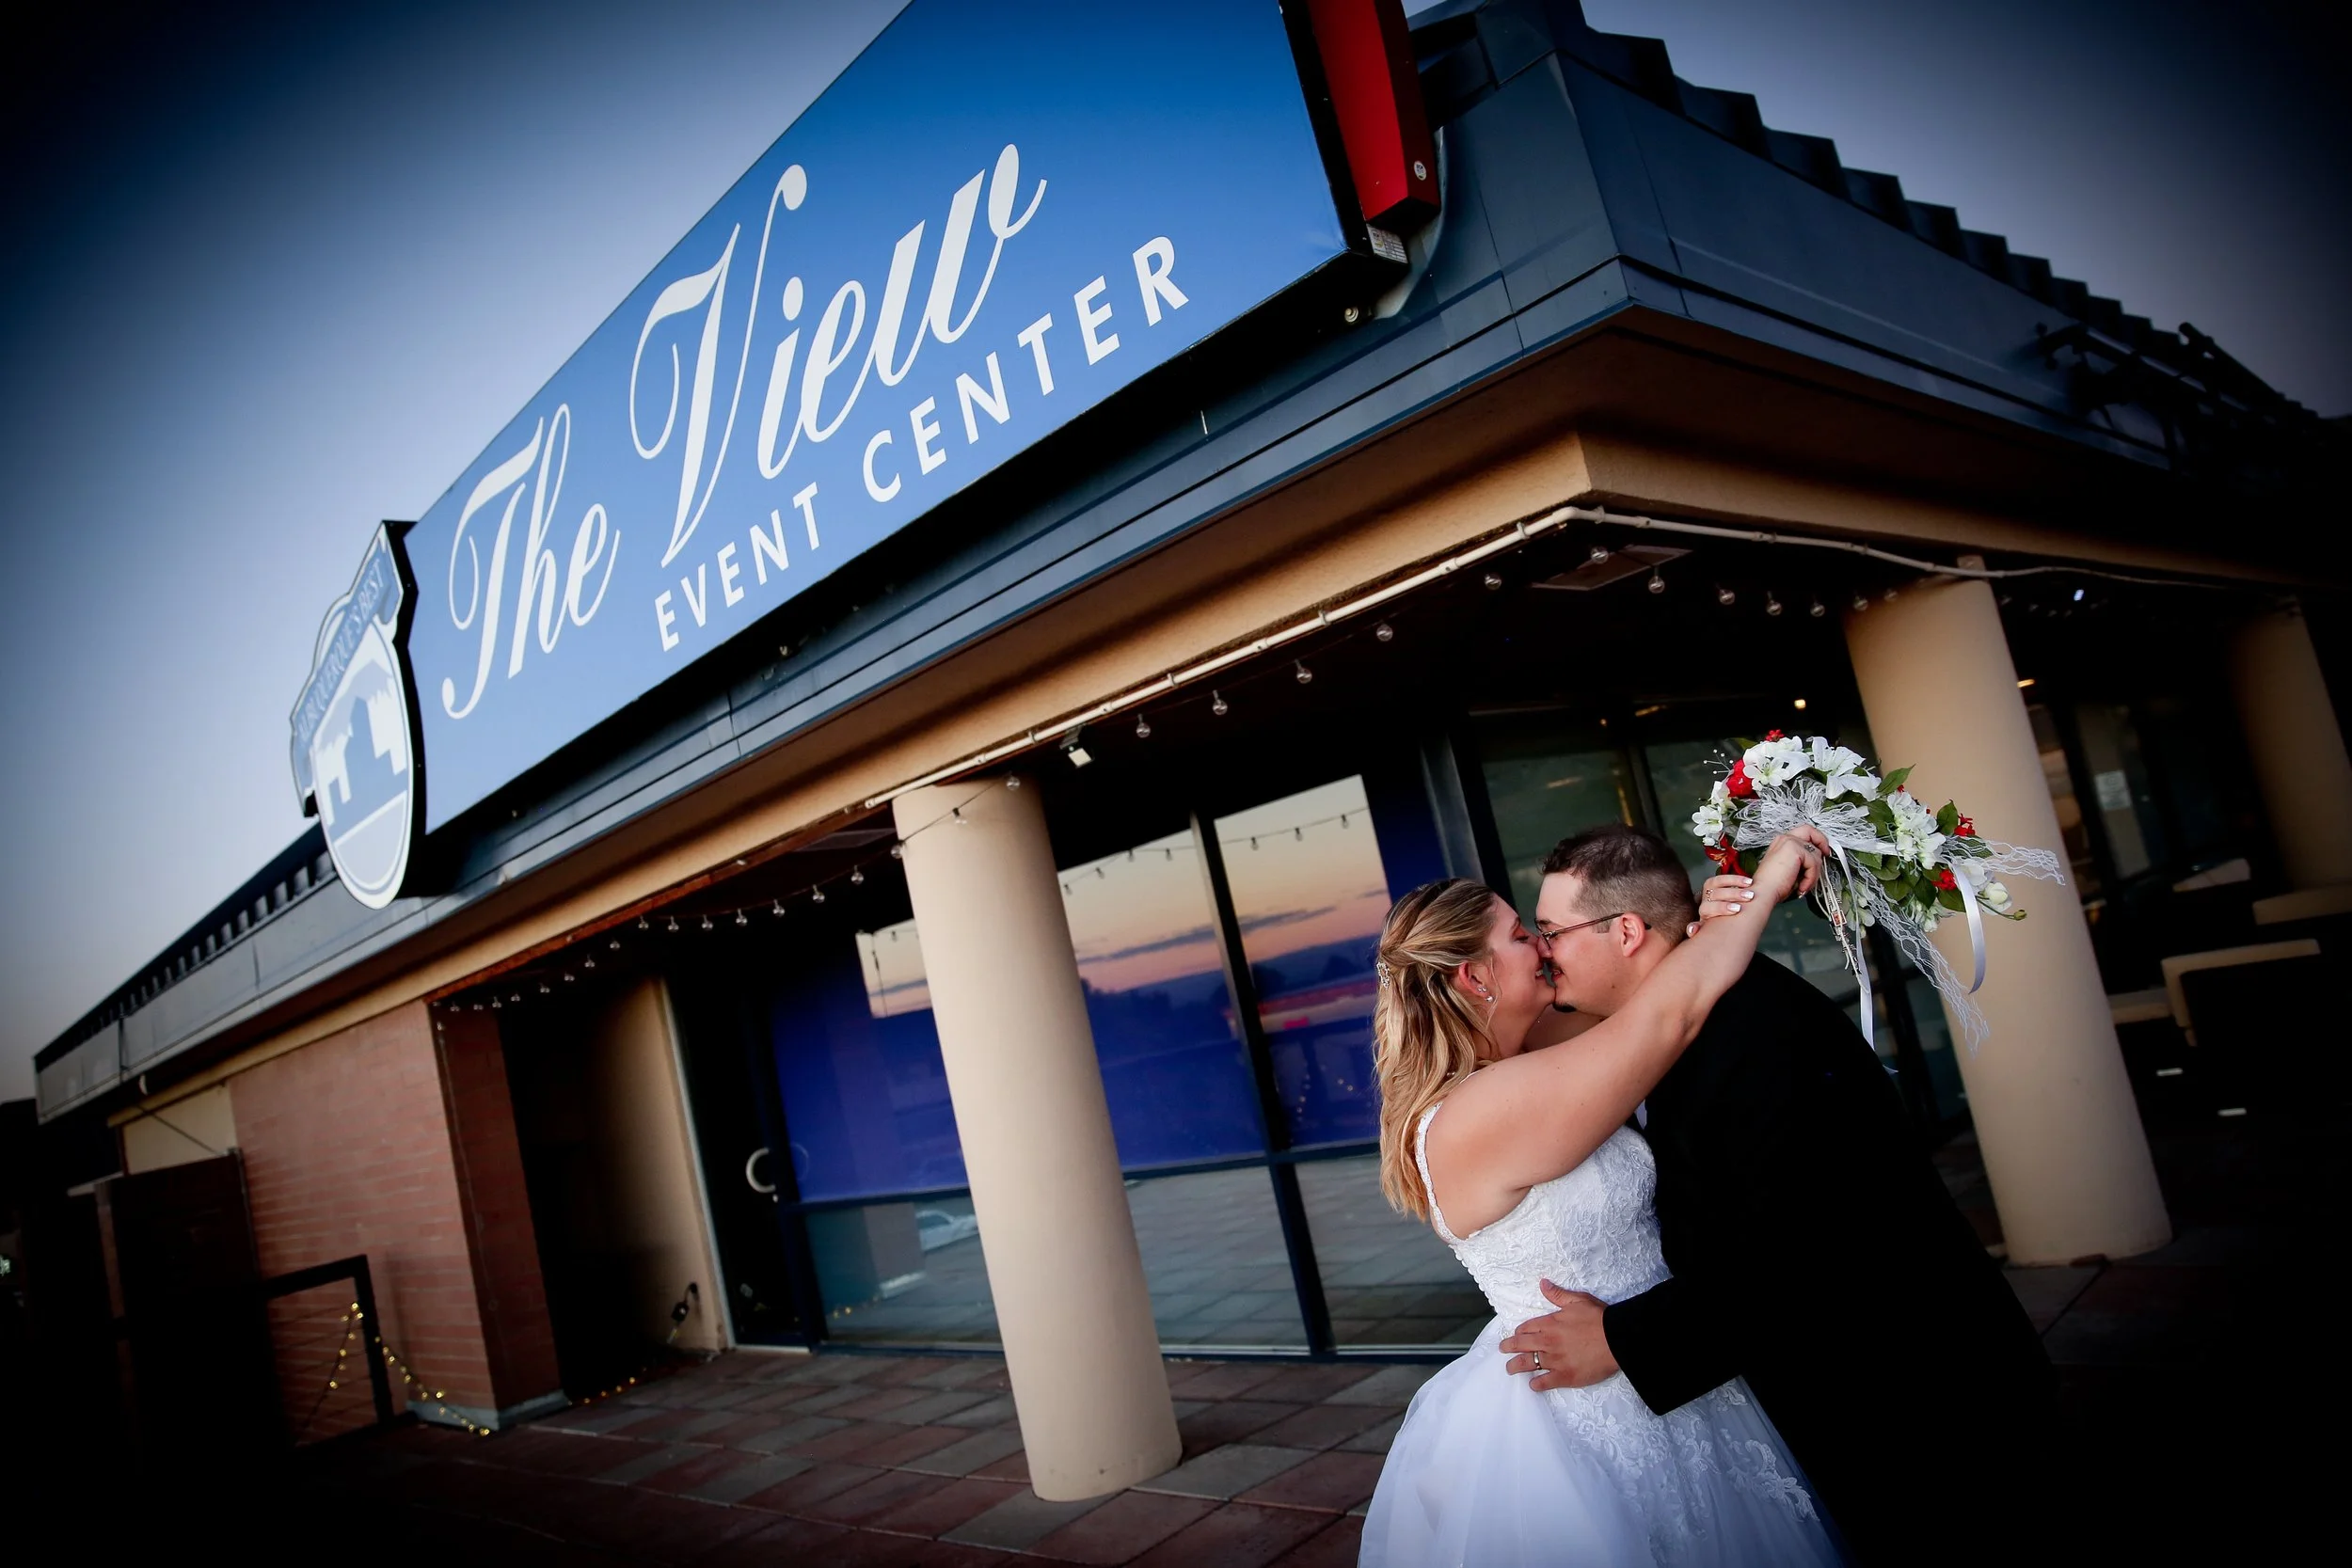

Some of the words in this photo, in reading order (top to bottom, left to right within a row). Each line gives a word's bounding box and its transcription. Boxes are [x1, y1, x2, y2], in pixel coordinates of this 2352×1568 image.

[358, 558, 385, 622] BEST
[441, 403, 621, 720] The
[629, 143, 1047, 568] View
[655, 482, 819, 652] EVENT
[863, 236, 1189, 502] CENTER
